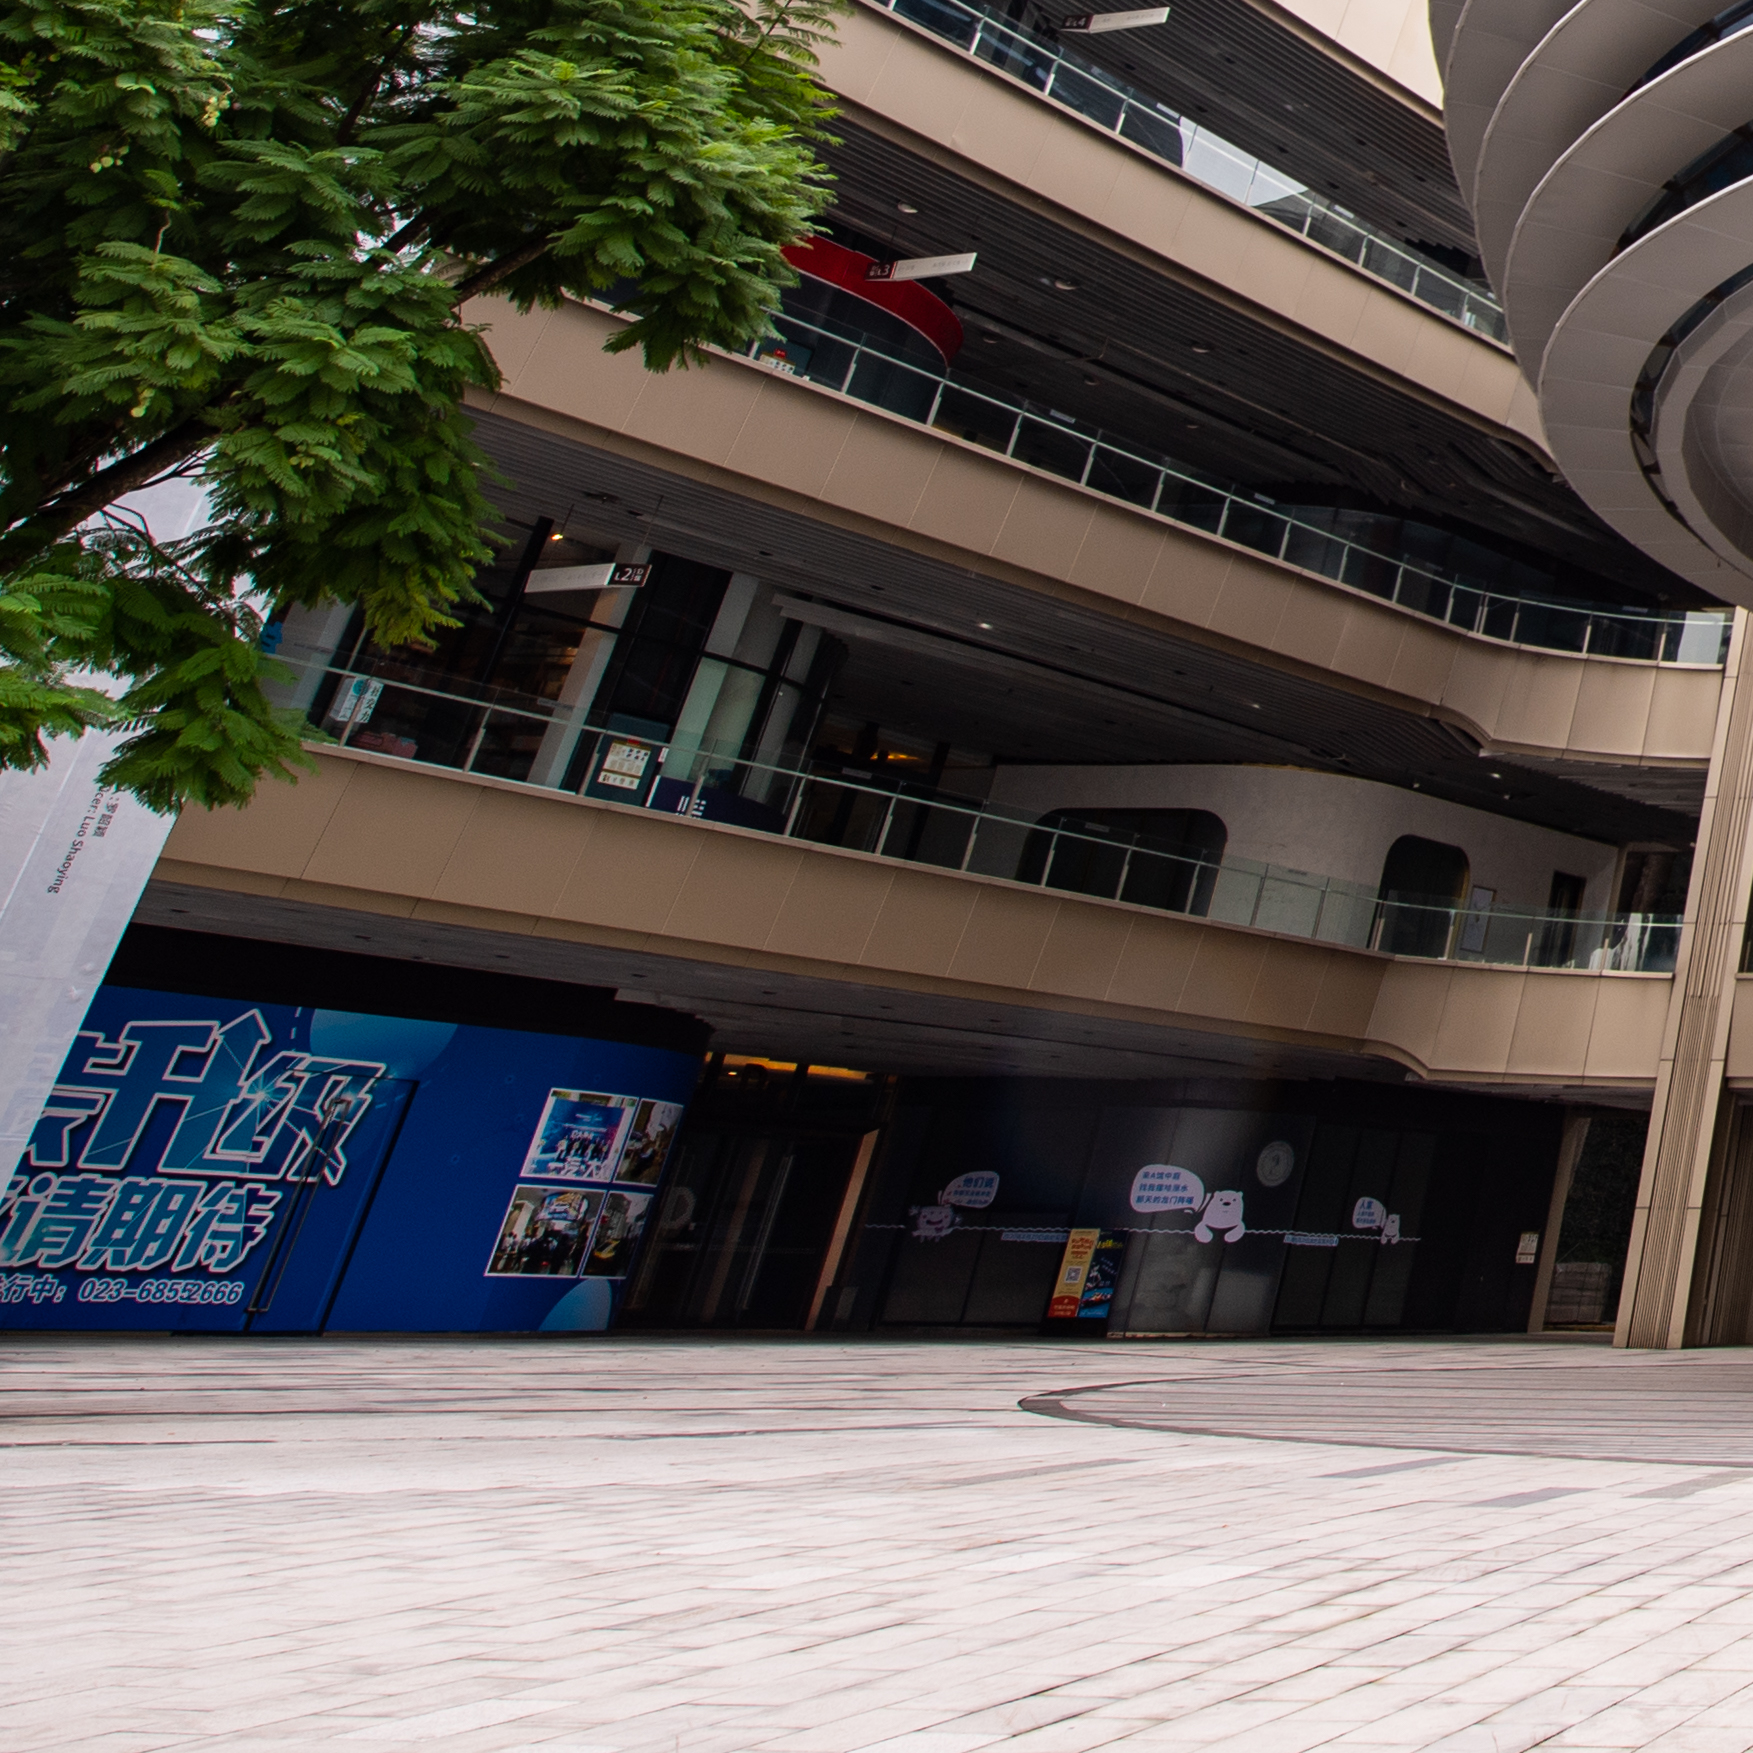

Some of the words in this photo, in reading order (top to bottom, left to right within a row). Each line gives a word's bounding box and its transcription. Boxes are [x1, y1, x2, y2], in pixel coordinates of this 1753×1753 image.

[77, 815, 96, 837] Luo
[46, 840, 85, 894] Shaoying
[0, 1171, 284, 1274] 请期待
[78, 1277, 245, 1305] 023-68552666
